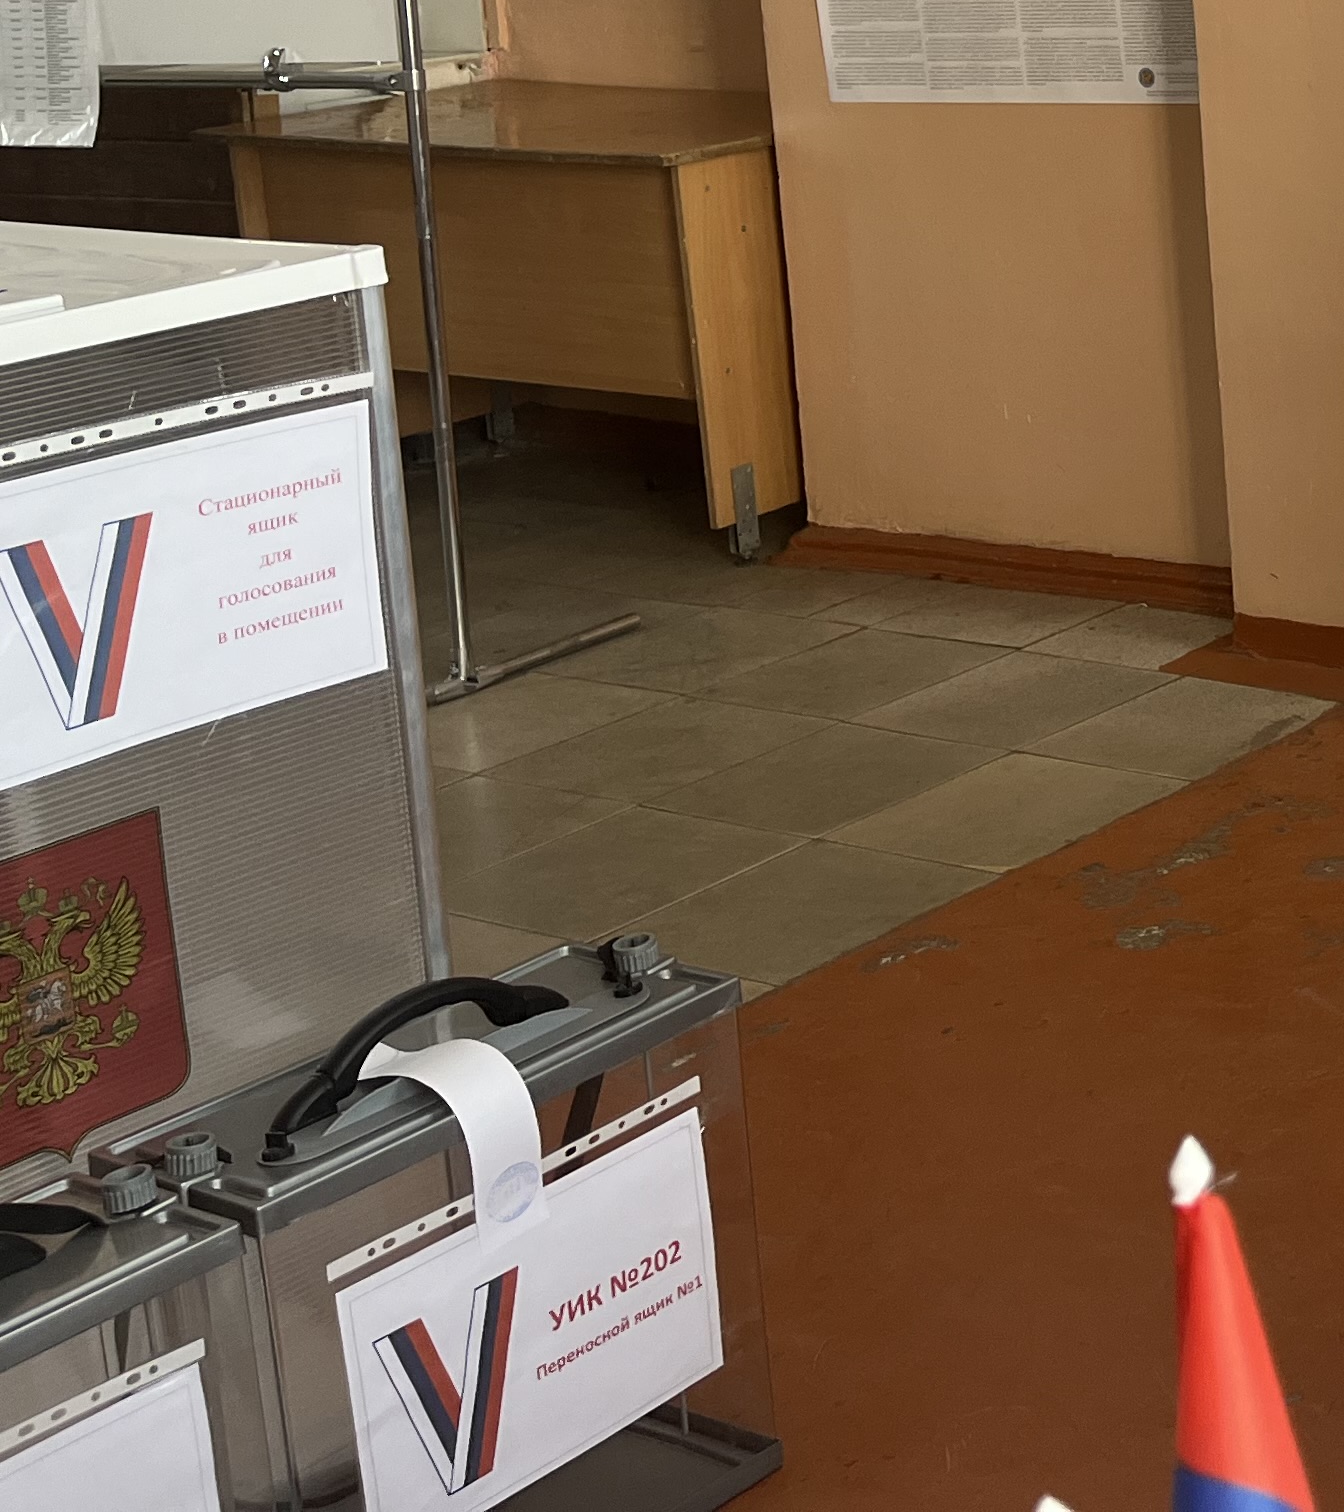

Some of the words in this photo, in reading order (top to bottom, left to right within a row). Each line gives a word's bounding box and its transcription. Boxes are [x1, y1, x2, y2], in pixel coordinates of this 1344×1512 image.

[198, 467, 343, 518] Стационарный
[247, 512, 299, 536] ящик
[259, 548, 292, 570] для
[218, 565, 337, 610] голосования
[218, 630, 228, 645] в
[234, 598, 344, 641] помещении
[549, 1284, 603, 1331] УИК
[610, 1240, 682, 1298] №202
[536, 1314, 630, 1380] Переносной
[634, 1293, 673, 1325] ящик
[677, 1275, 702, 1299] №1
